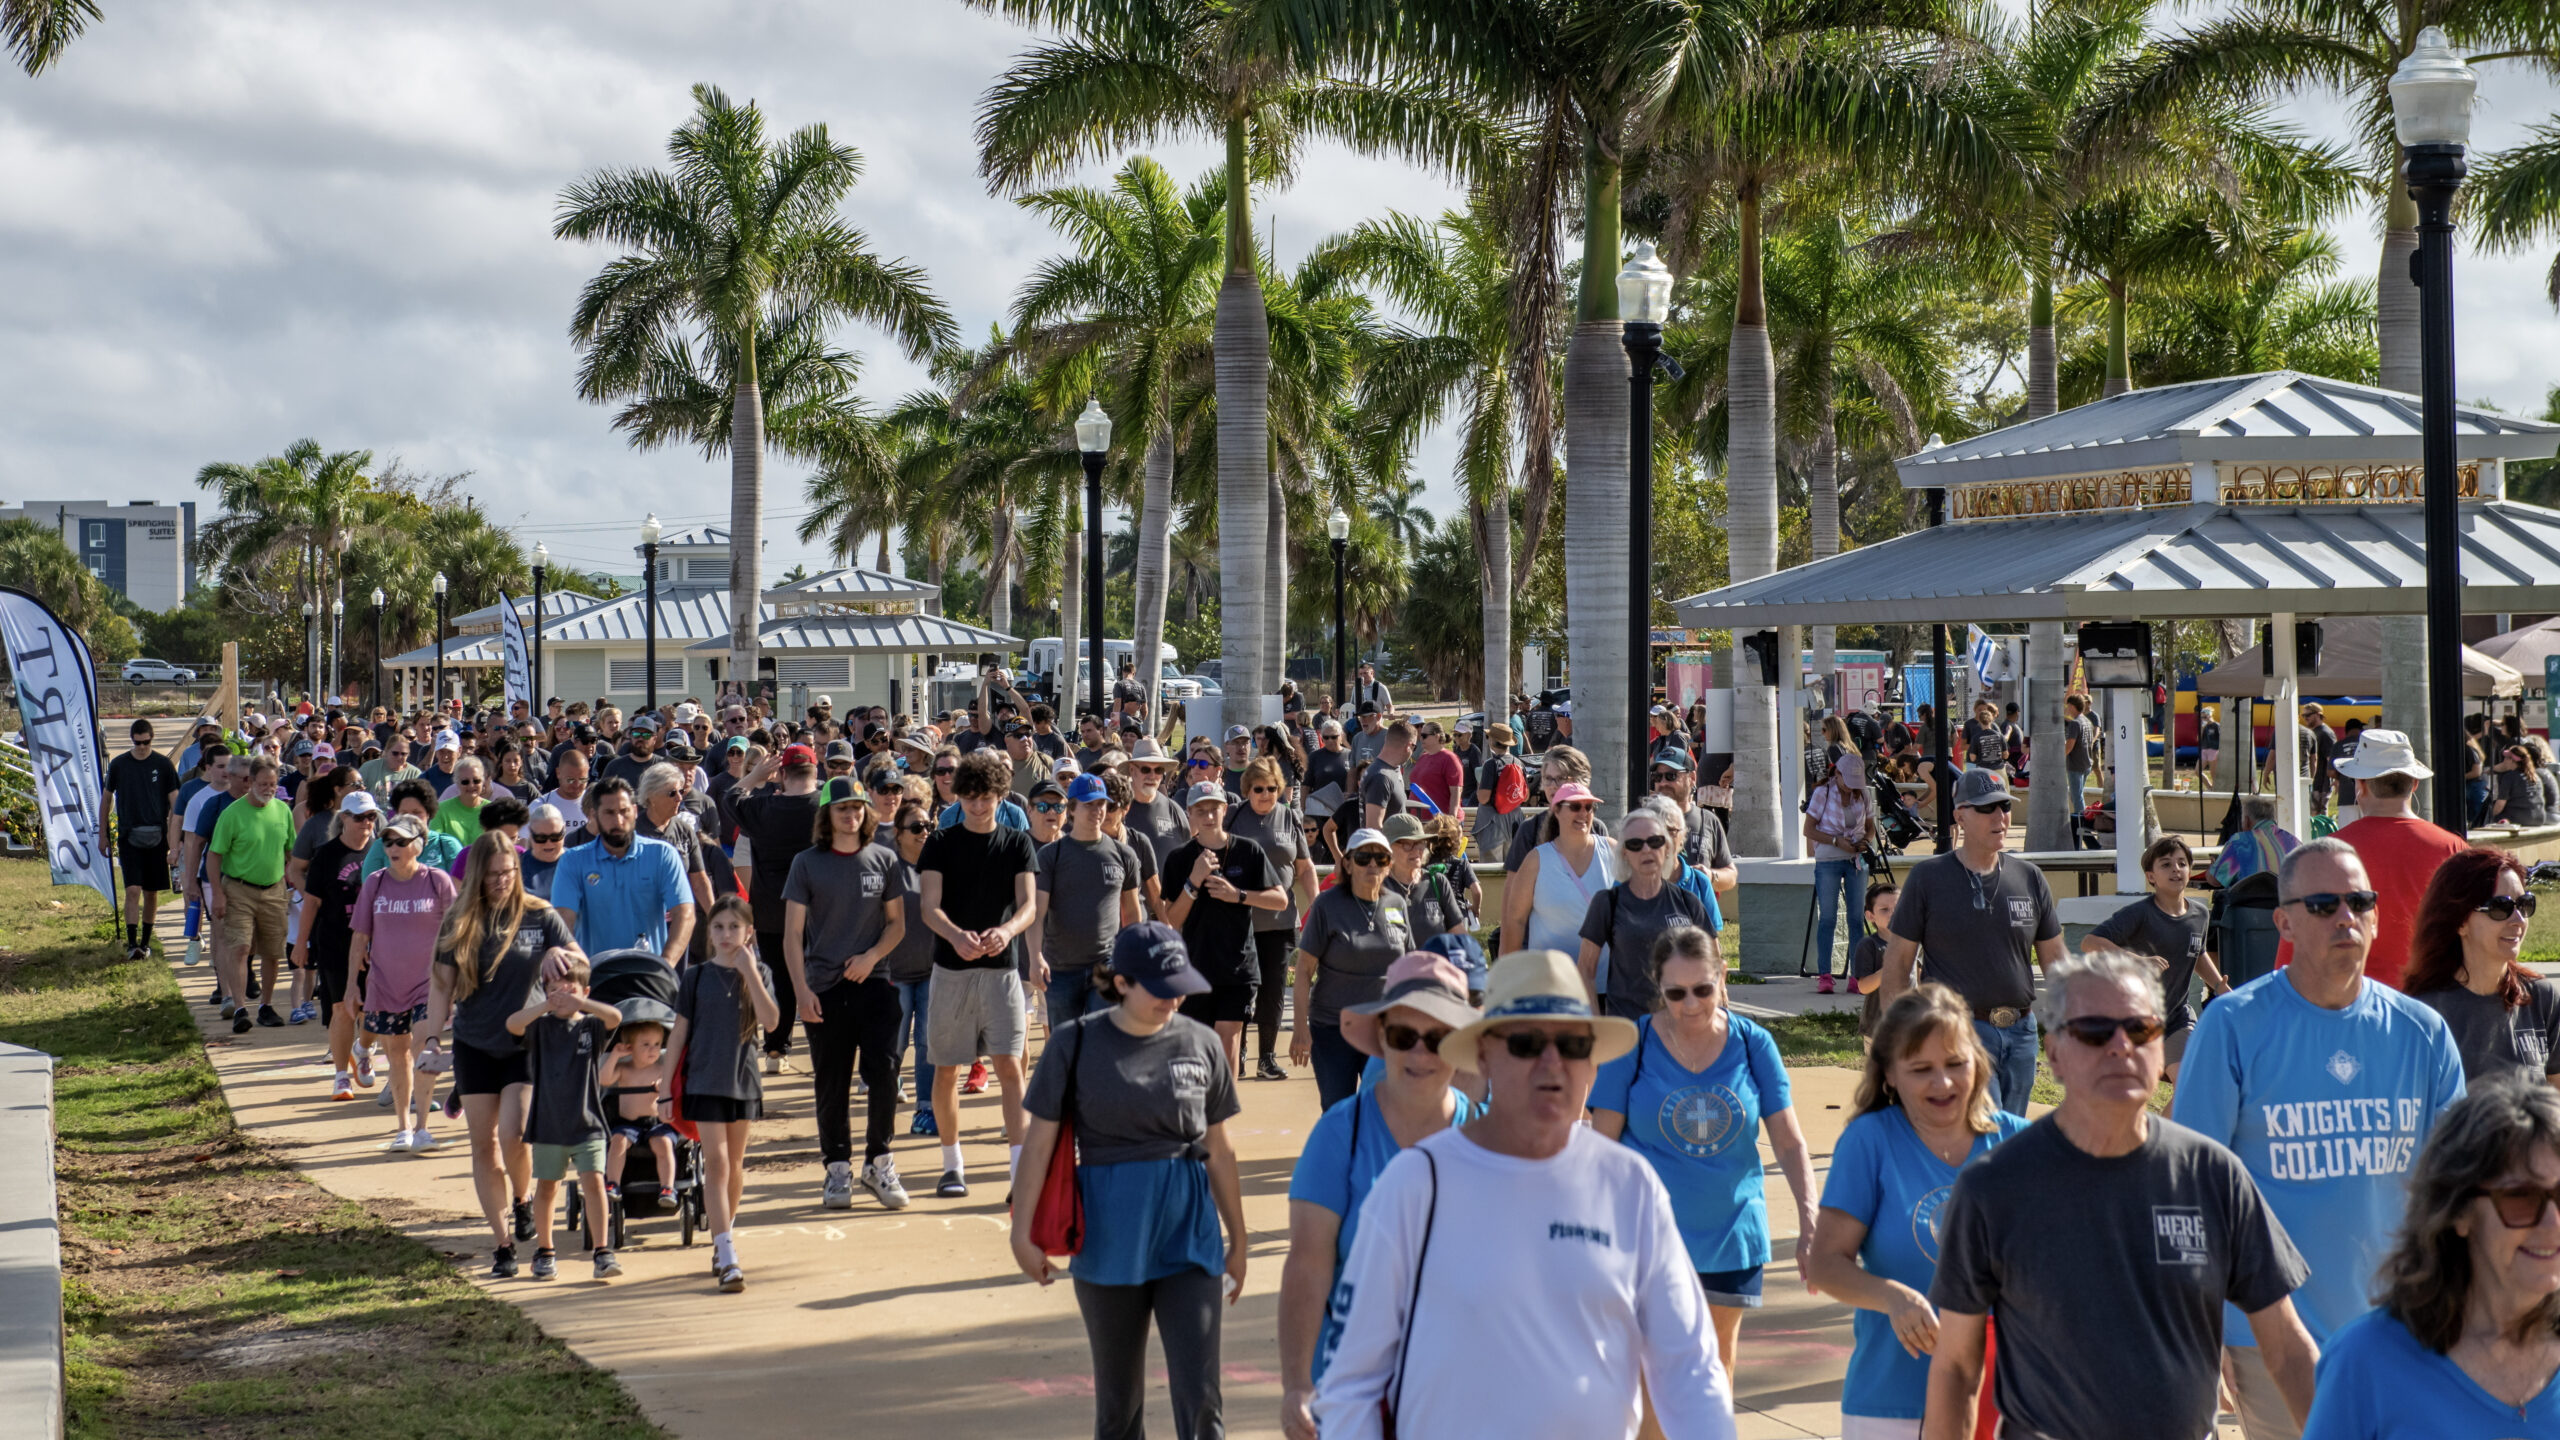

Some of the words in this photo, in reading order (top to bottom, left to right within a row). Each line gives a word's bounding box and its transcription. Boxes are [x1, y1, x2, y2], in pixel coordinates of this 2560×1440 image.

[2121, 725, 2127, 740] 3
[388, 899, 409, 913] LAKE
[2262, 1098, 2391, 1137] KNIGHTS
[2398, 1097, 2422, 1132] OF
[2269, 1136, 2416, 1180] COLUMBUS
[2157, 1214, 2204, 1237] HERE
